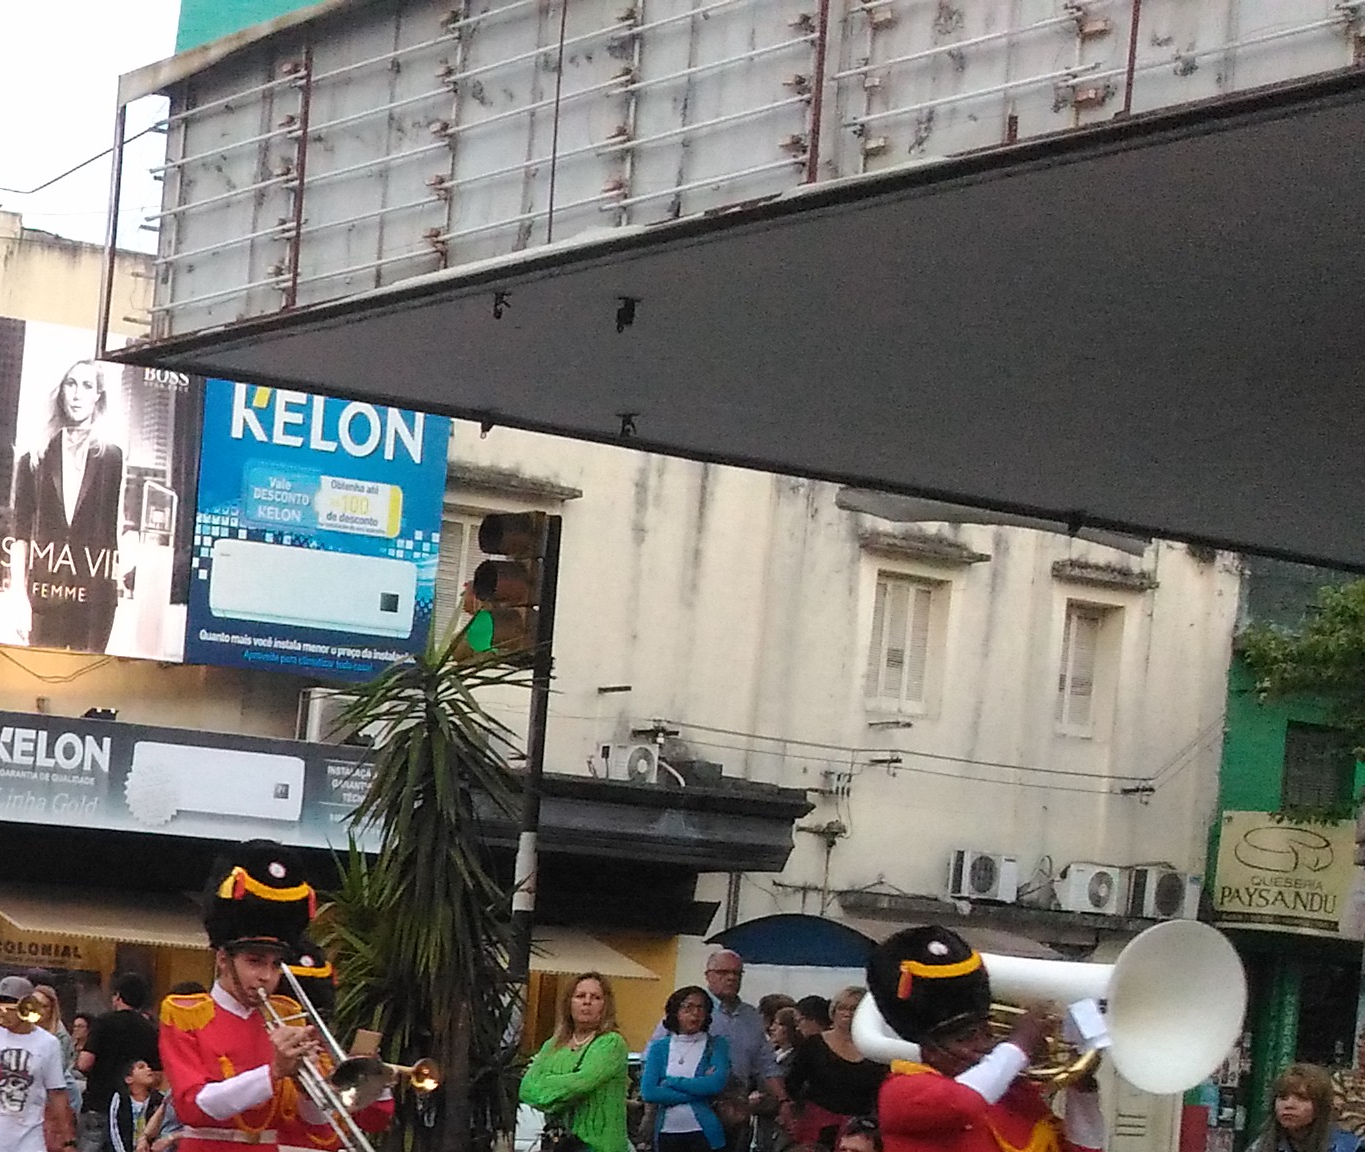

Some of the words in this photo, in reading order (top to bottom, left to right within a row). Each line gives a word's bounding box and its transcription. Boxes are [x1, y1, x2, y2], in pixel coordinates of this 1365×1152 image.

[231, 382, 425, 465] KELON
[253, 487, 311, 507] DESCONTO
[257, 505, 302, 523] KELON
[338, 512, 379, 528] desconto
[28, 539, 78, 576] MA
[32, 581, 87, 602] FEMME
[199, 628, 230, 643] Quanto
[231, 633, 252, 646] mais
[38, 772, 51, 782] DE
[51, 773, 96, 786] QUALIDADE
[52, 792, 100, 815] Gold
[1219, 885, 1338, 915] PAYSANDU
